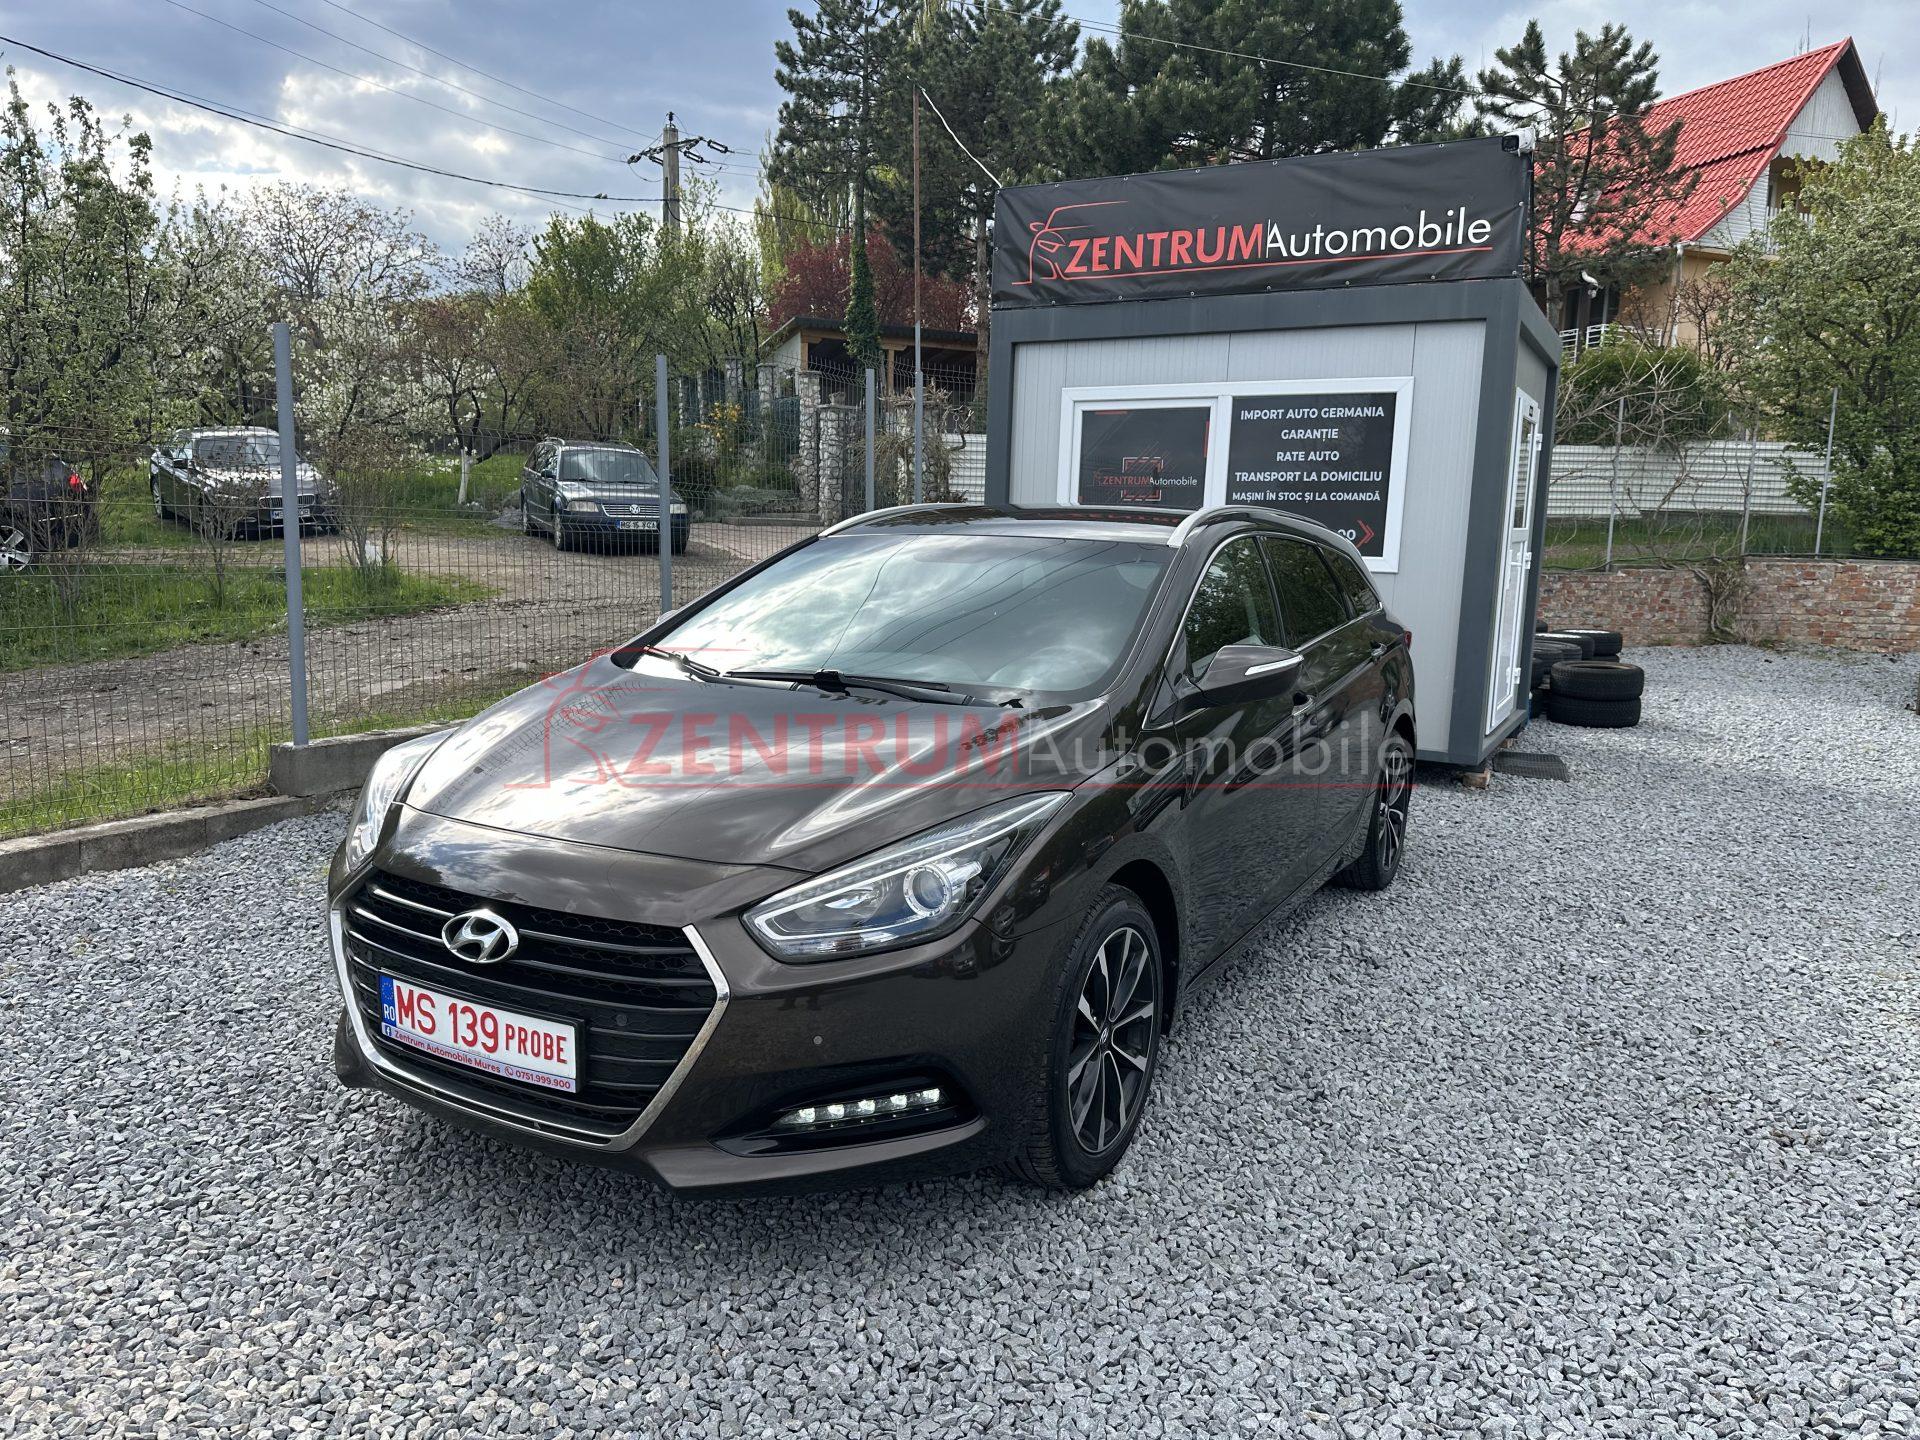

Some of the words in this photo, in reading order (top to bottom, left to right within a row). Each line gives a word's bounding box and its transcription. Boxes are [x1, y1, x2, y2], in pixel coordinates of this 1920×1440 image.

[1064, 223, 1263, 273] ZENTRUM
[1266, 206, 1492, 258] Automobile
[1240, 409, 1284, 420] IMPORT
[1286, 408, 1318, 419] AUTO
[1321, 407, 1384, 418] GERMANIA
[1281, 428, 1339, 442] GARANȚIE
[1276, 451, 1305, 461] RATE
[1308, 451, 1340, 461] AUTO
[1103, 476, 1150, 485] ZENTRUM
[1150, 476, 1198, 486] Automobile
[1235, 472, 1301, 482] TRANSPORT
[1303, 472, 1318, 481] LA
[1321, 471, 1382, 481] DOMICILIU
[1232, 492, 1264, 503] MAȘINI
[1266, 490, 1277, 500] ÎN
[1278, 492, 1302, 501] STOC
[1304, 492, 1313, 503] ȘI
[1315, 492, 1328, 501] LA
[1330, 490, 1381, 501] COMANDĂ
[383, 1004, 396, 1021] RO
[396, 985, 436, 1035] MS
[448, 1002, 499, 1054] 139
[505, 1023, 568, 1065] PROBE
[394, 1030, 425, 1049] Zentrum
[426, 1043, 473, 1064] Automobile
[474, 1057, 501, 1074] Mures
[515, 1071, 571, 1090] 0751.999.900
